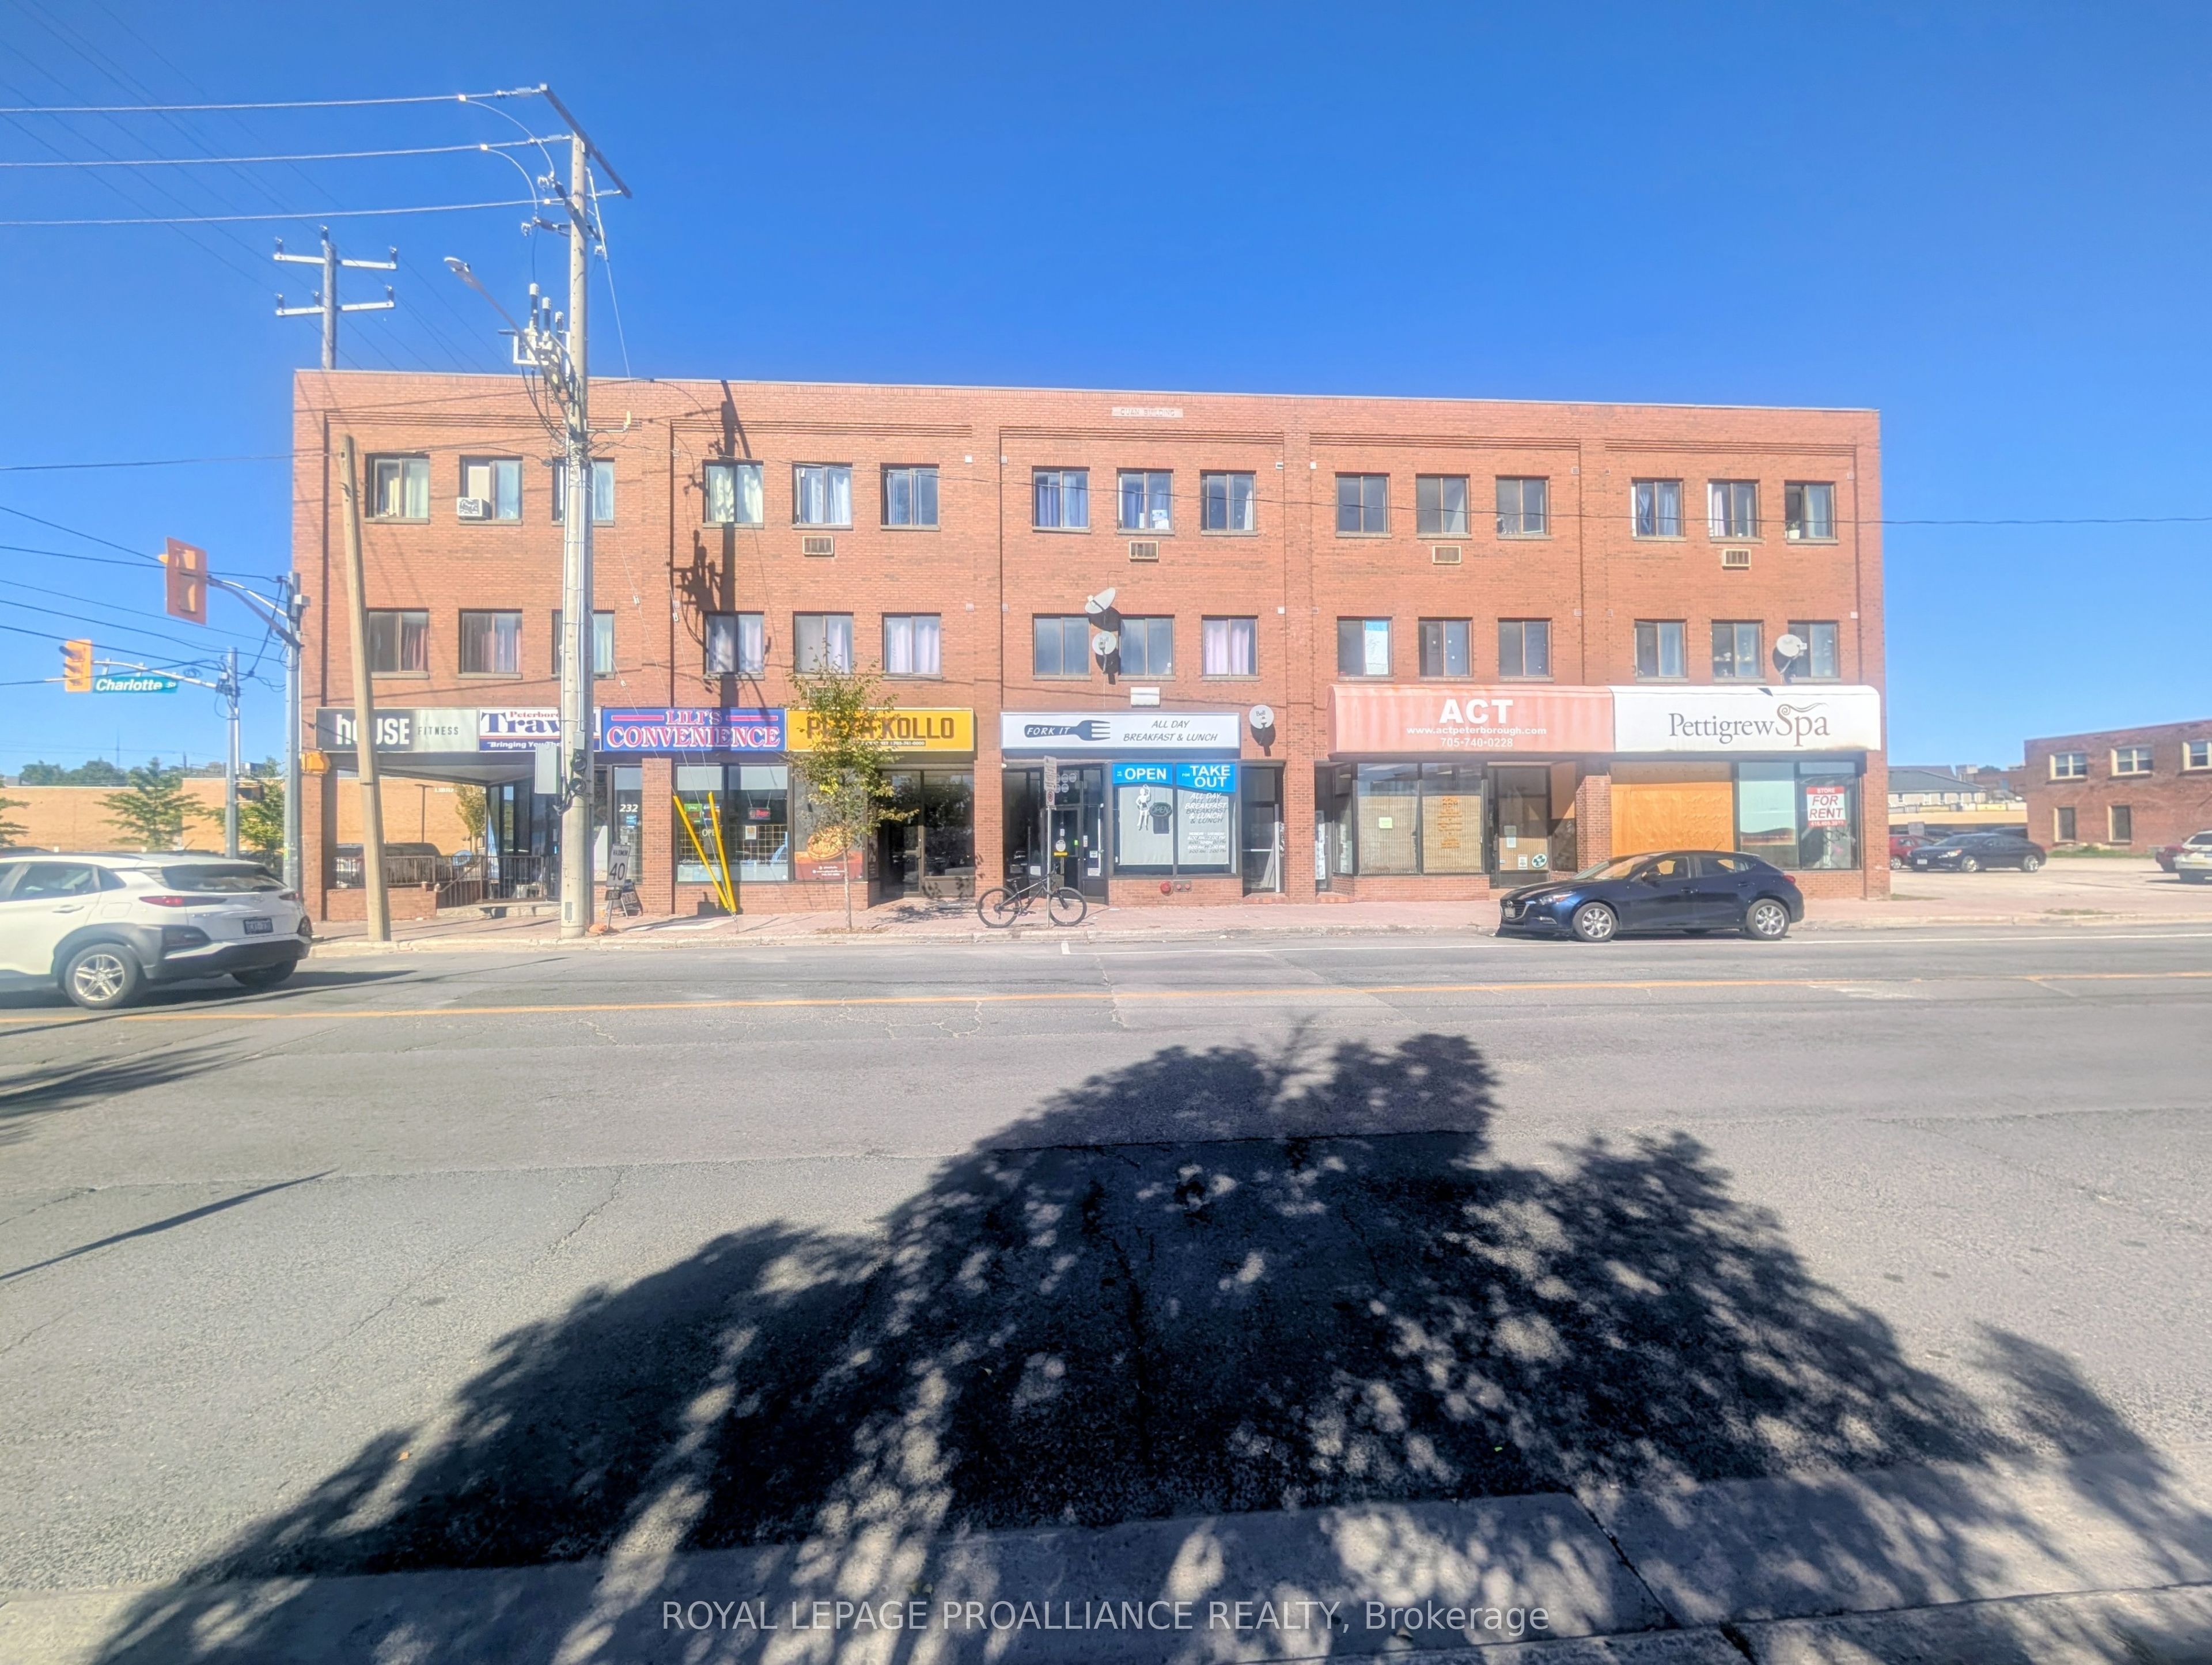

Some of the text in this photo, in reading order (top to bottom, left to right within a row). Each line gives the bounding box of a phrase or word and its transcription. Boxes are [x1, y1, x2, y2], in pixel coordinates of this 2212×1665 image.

[96, 678, 163, 691] Charlotte
[1439, 698, 1513, 724] ACT
[665, 710, 722, 725] LILI'S
[882, 717, 955, 739] KOLLO
[1152, 720, 1190, 728] ALL DAY
[1668, 702, 1831, 747] Pettigrew Spa
[418, 726, 459, 735] FITNESS
[1027, 727, 1055, 736] FORK
[1406, 726, 1547, 736] www.actpeterborough.com
[607, 726, 781, 748] CONVENIENCE
[1123, 733, 1218, 741] BREAKFAST & LUNCH
[1124, 767, 1166, 780] OPEN
[1190, 765, 1231, 776] TAKE
[1194, 777, 1227, 788] OUT
[1812, 796, 1838, 805] FOR
[619, 804, 639, 812] 232
[1809, 808, 1844, 819] RENT
[702, 828, 721, 837] OPE
[609, 862, 626, 880] 40
